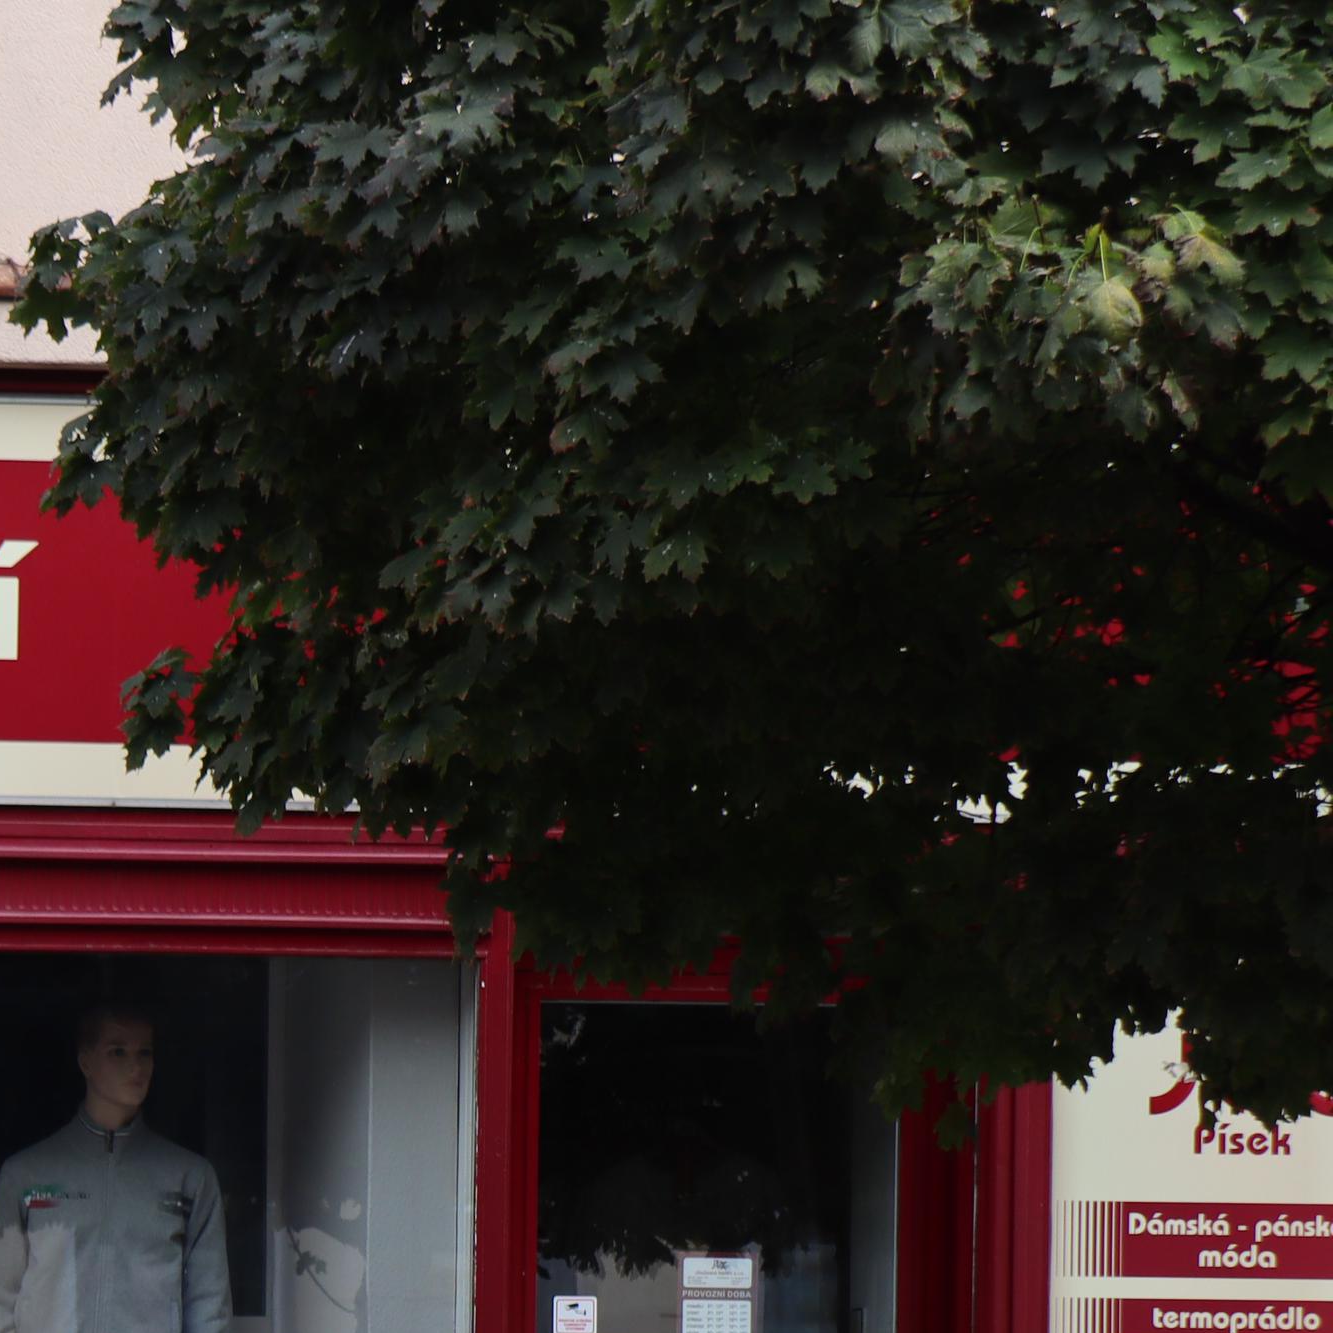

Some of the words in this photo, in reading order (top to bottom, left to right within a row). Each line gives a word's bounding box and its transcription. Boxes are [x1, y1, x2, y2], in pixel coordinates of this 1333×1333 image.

[1194, 1122, 1291, 1156] Písek
[1128, 1211, 1231, 1236] Dámská
[1198, 1243, 1278, 1269] móda
